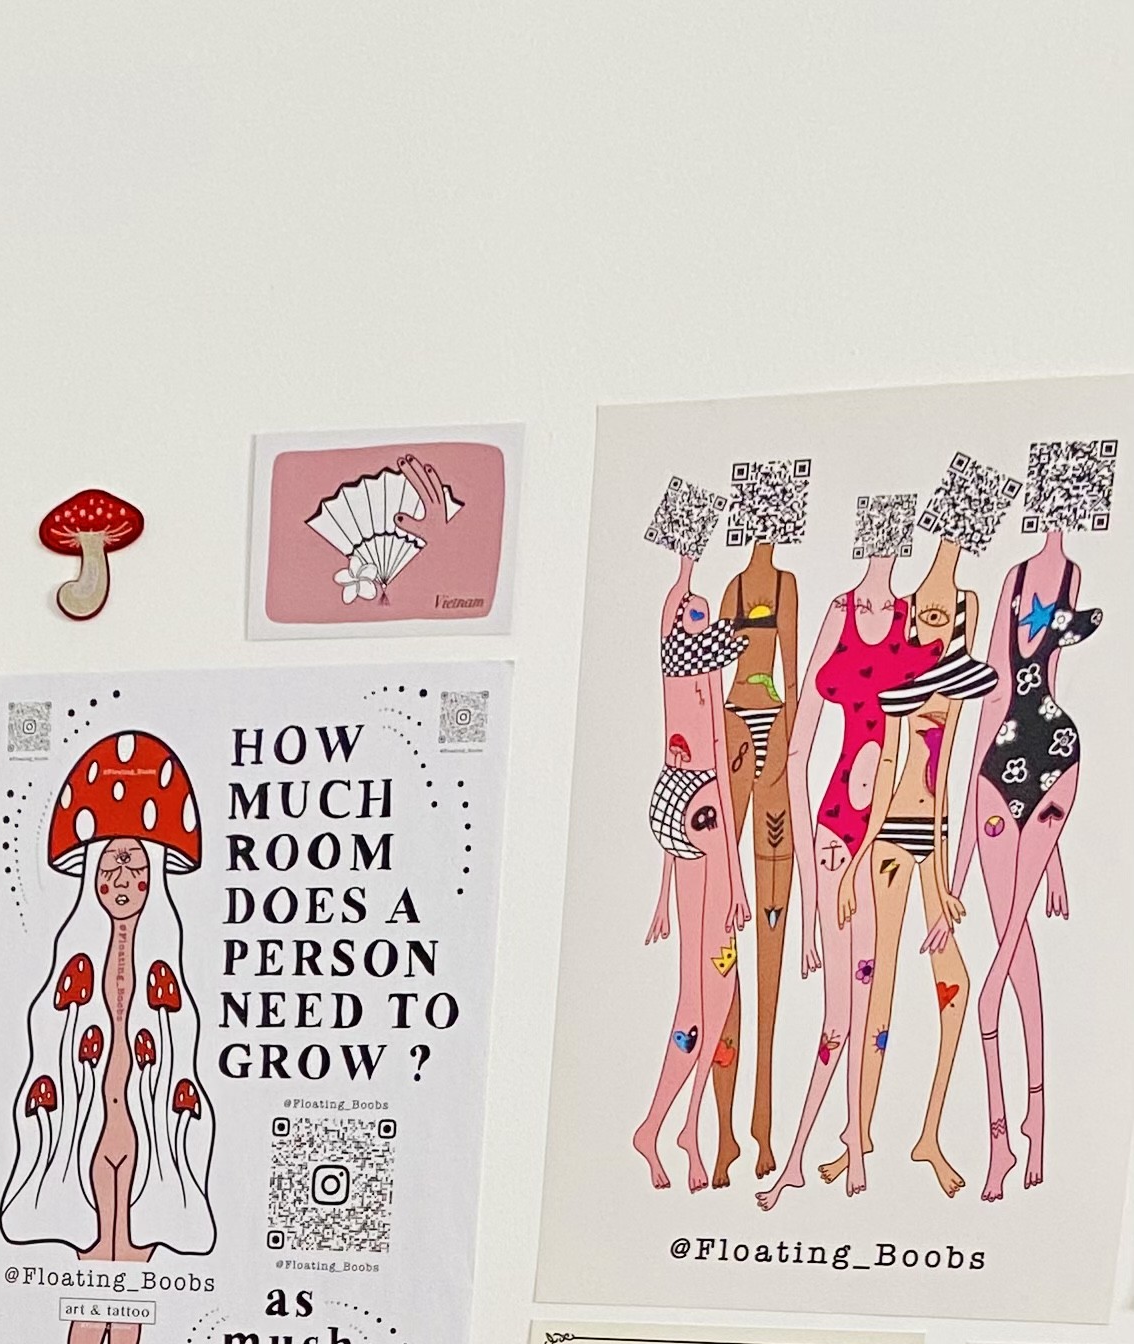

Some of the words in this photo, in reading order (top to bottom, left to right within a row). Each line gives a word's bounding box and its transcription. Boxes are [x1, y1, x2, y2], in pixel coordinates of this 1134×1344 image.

[434, 594, 485, 609] Vietnam
[230, 724, 366, 767] HOW
[227, 778, 394, 821] MUCH
[225, 831, 395, 873] ROOM
[222, 886, 368, 925] DOES
[384, 886, 421, 924] A
[222, 938, 440, 979] PERSON
[218, 991, 364, 1030] NEED
[387, 992, 460, 1030] TO
[218, 1042, 388, 1082] GROW
[283, 1098, 390, 1112] @Floating_Boobs
[274, 1259, 380, 1274] @Floating_Boobs
[670, 1236, 986, 1271] @Floating_Boobs
[4, 1265, 216, 1293] @Floating_Boobs
[65, 1304, 85, 1316] art
[90, 1305, 101, 1317] &
[107, 1306, 151, 1319] tattoo
[265, 1288, 314, 1319] as
